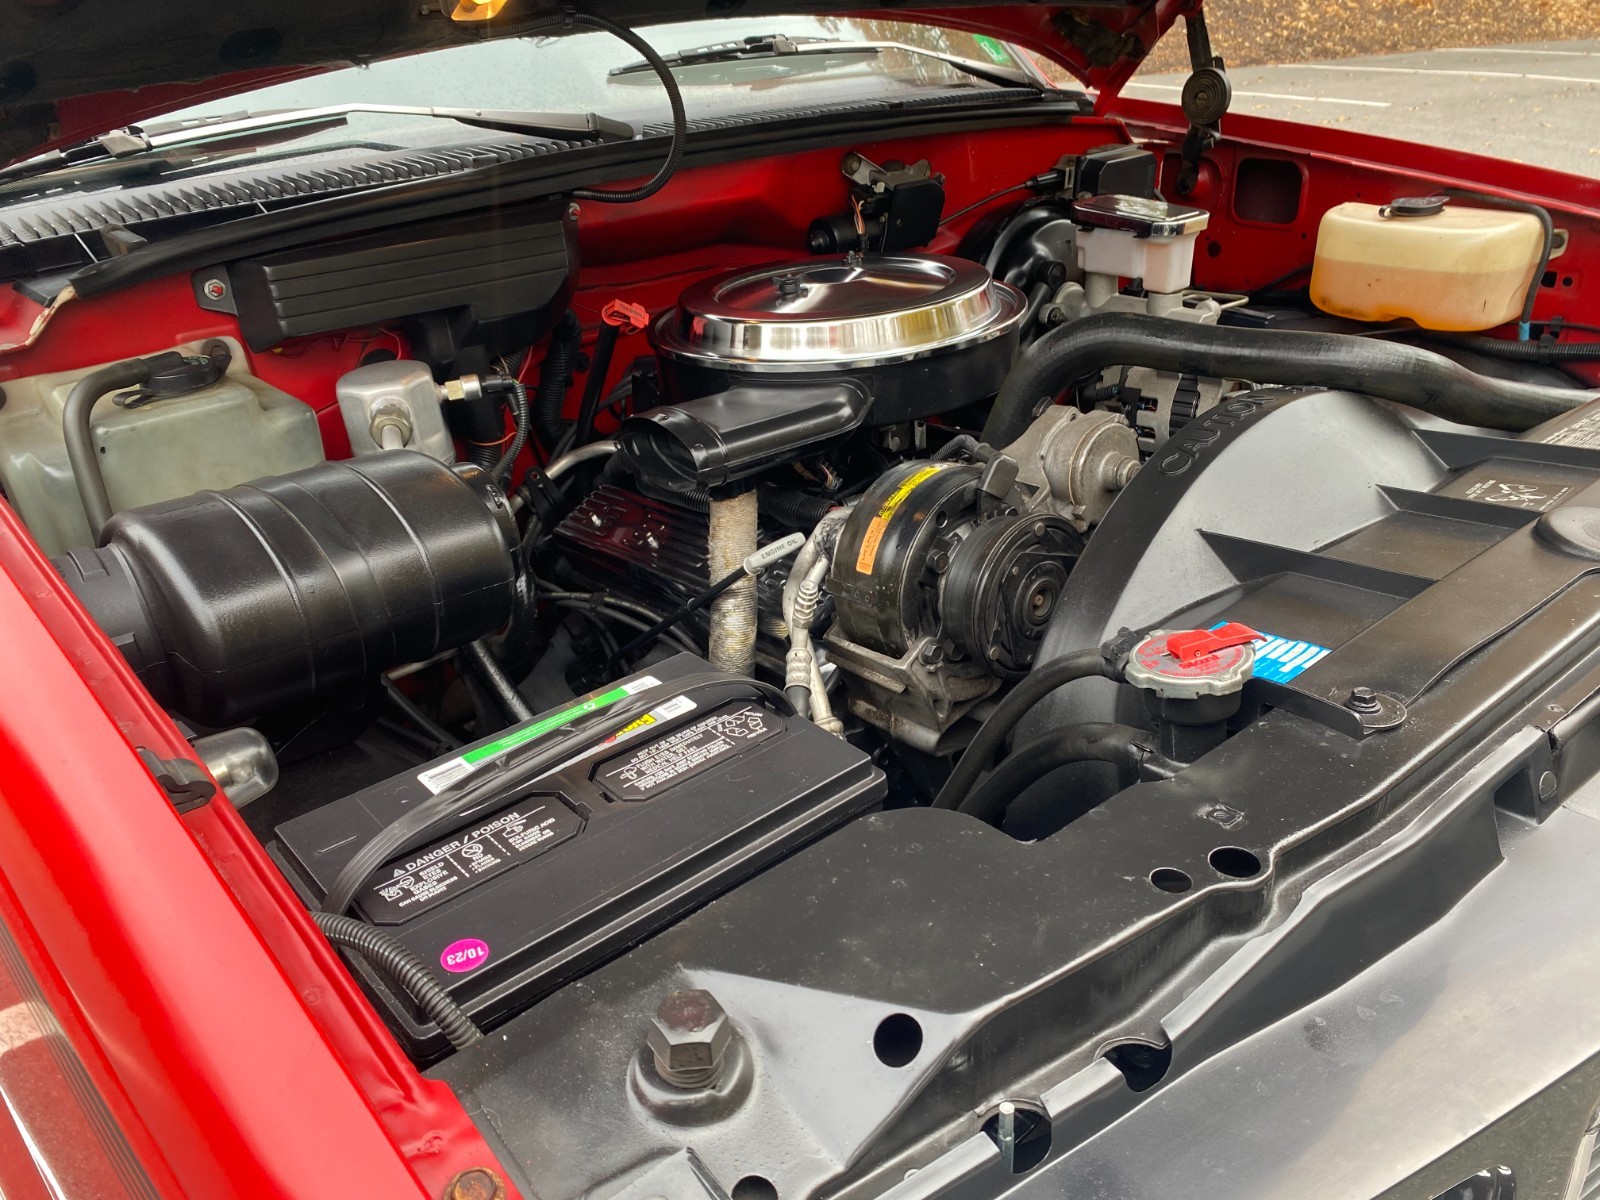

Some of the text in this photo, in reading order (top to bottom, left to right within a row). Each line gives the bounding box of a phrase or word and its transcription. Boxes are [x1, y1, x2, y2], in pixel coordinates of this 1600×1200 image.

[1159, 395, 1276, 476] CAUTION
[760, 539, 798, 560] ENGINE OIL
[1178, 654, 1220, 669] Stant
[538, 817, 556, 827] ACID
[406, 841, 461, 870] DANGER
[472, 812, 520, 838] POISON
[418, 861, 444, 876] SHIELD
[422, 868, 442, 880] EYES
[409, 869, 448, 891] EXPLOSIVE
[412, 880, 438, 894] GASES
[446, 946, 485, 965] 10/23
